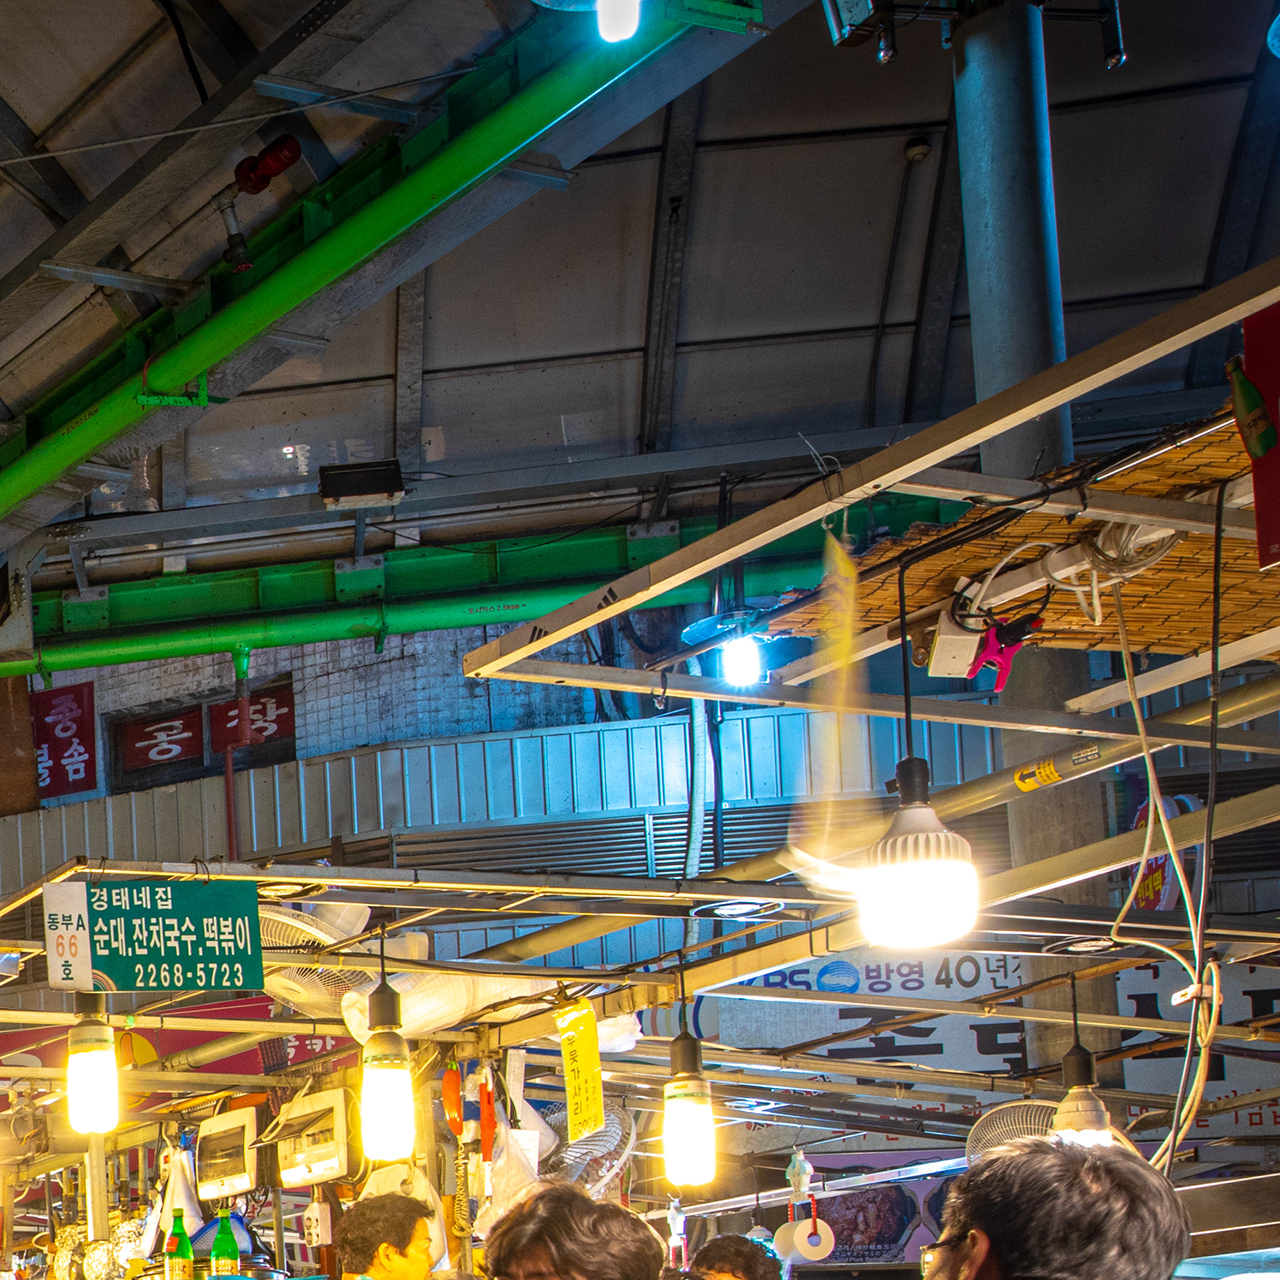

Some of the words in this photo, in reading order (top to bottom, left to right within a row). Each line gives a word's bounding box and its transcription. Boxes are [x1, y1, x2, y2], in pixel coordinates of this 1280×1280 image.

[90, 886, 173, 911] 경태네집
[47, 913, 86, 931] 동부A
[56, 934, 78, 958] 66
[61, 960, 74, 981] 호
[135, 963, 244, 987] 2268-5723
[865, 960, 925, 993] 방영
